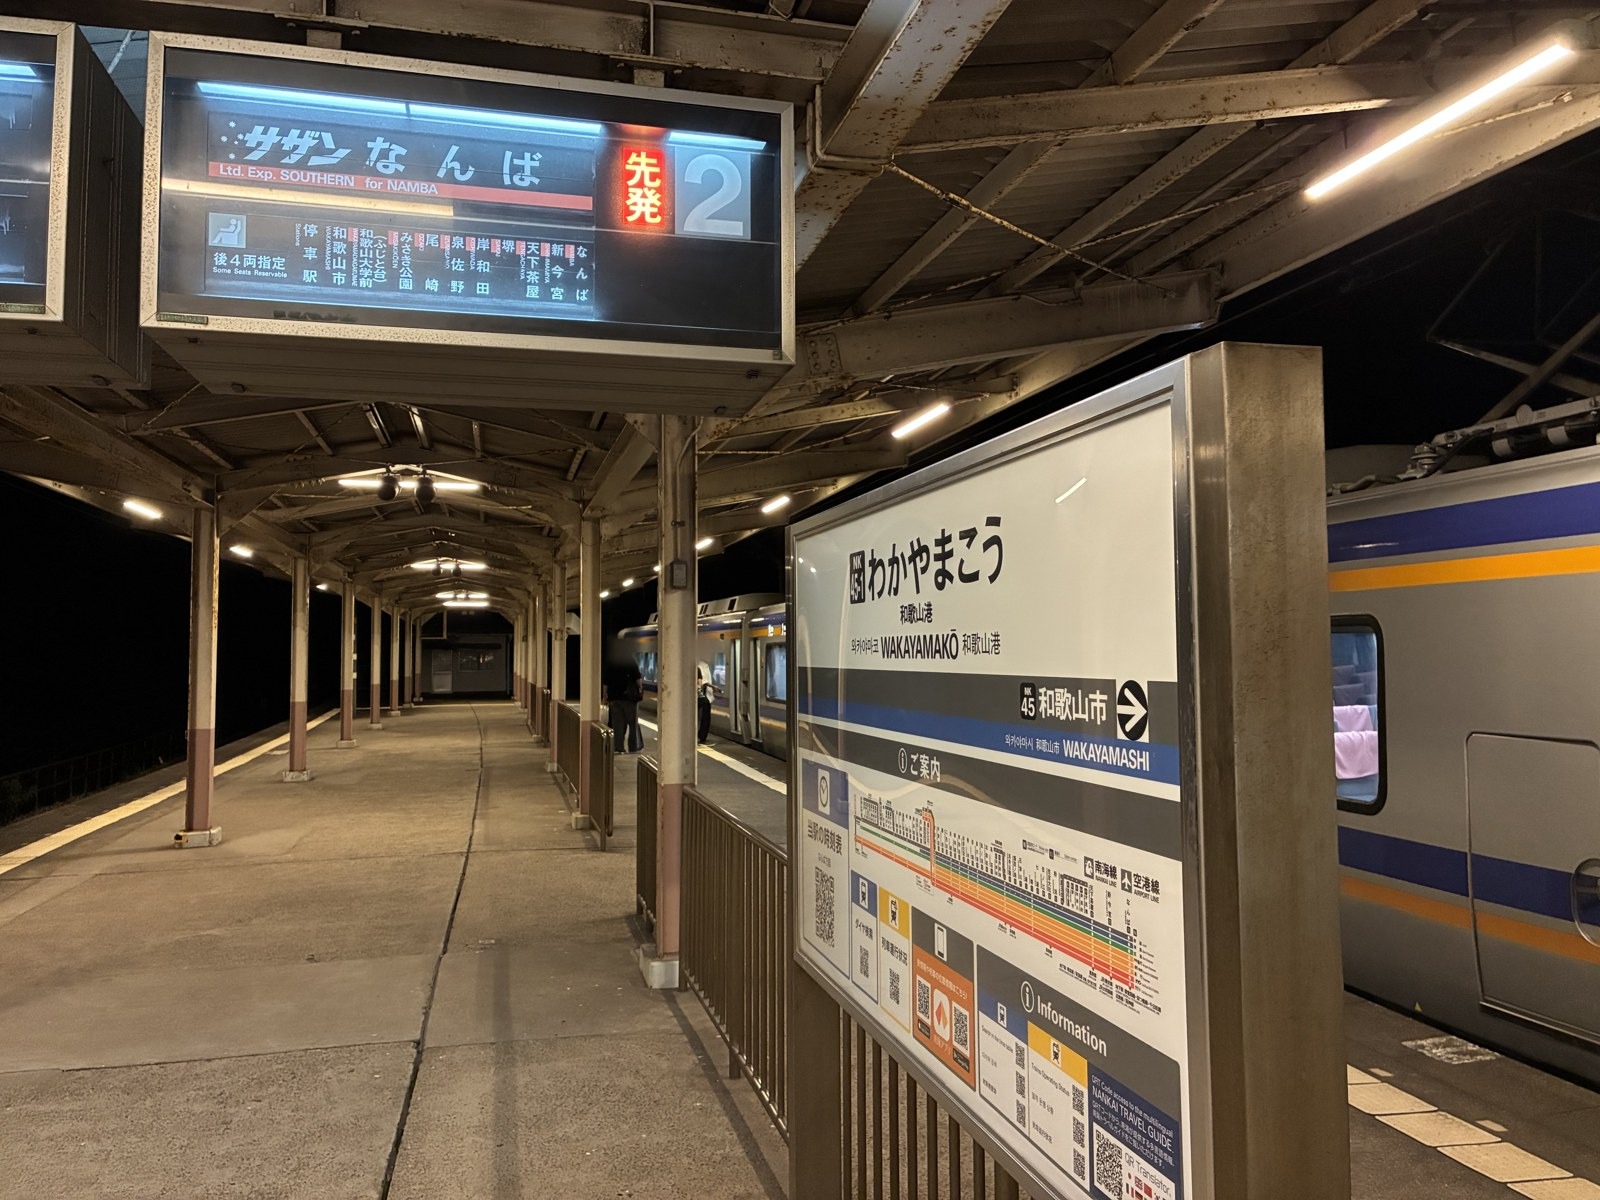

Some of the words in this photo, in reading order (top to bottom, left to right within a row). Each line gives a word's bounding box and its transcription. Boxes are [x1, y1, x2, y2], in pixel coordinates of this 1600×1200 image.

[243, 125, 352, 166] サザン
[365, 136, 543, 188] なんば
[219, 165, 244, 177] Ltd.
[247, 167, 276, 181] Exp.
[280, 169, 355, 187] SOUTHERN
[365, 178, 382, 189] for
[387, 178, 439, 195] NAMBA
[625, 151, 662, 224] 先発
[683, 153, 744, 236] 2
[303, 223, 318, 283] 停車駅
[332, 226, 347, 286] 和歌山市
[358, 228, 374, 288] 和歌山大学前
[399, 232, 413, 290] みさき公園
[425, 233, 439, 292] 尾崎
[451, 235, 465, 294] 泉佐野
[502, 240, 515, 253] 堺
[234, 268, 251, 276] Seats
[254, 270, 287, 278] Reservable
[476, 238, 490, 295] 岸和田
[526, 241, 540, 299] 天下茶屋
[550, 243, 565, 300] 新今宮
[575, 245, 589, 301] なんば
[852, 555, 862, 570] NK
[868, 516, 1004, 601] わかやまこう
[900, 601, 933, 625] 和歌山港
[880, 629, 959, 660] WAKAYAMAKŌ
[961, 631, 1001, 656] 和歌山港
[1021, 698, 1035, 717] 45
[1023, 687, 1032, 696] NK
[1038, 687, 1108, 725] 和歌山市
[1004, 733, 1034, 751] 와카야마시
[1035, 739, 1060, 755] 和歌山市
[1062, 739, 1150, 772] WAKAYAMASHI
[910, 752, 941, 783] ご案内
[1094, 860, 1118, 880] 南海線
[1133, 873, 1160, 895] 空港線
[1037, 995, 1107, 1057] Information
[1100, 1081, 1113, 1096] Code
[1134, 1105, 1143, 1117] the
[1092, 1085, 1119, 1113] NANKAI
[1119, 1104, 1147, 1134] TRAVEL
[1147, 1125, 1174, 1154] GUIDE.
[1124, 1152, 1135, 1169] QR
